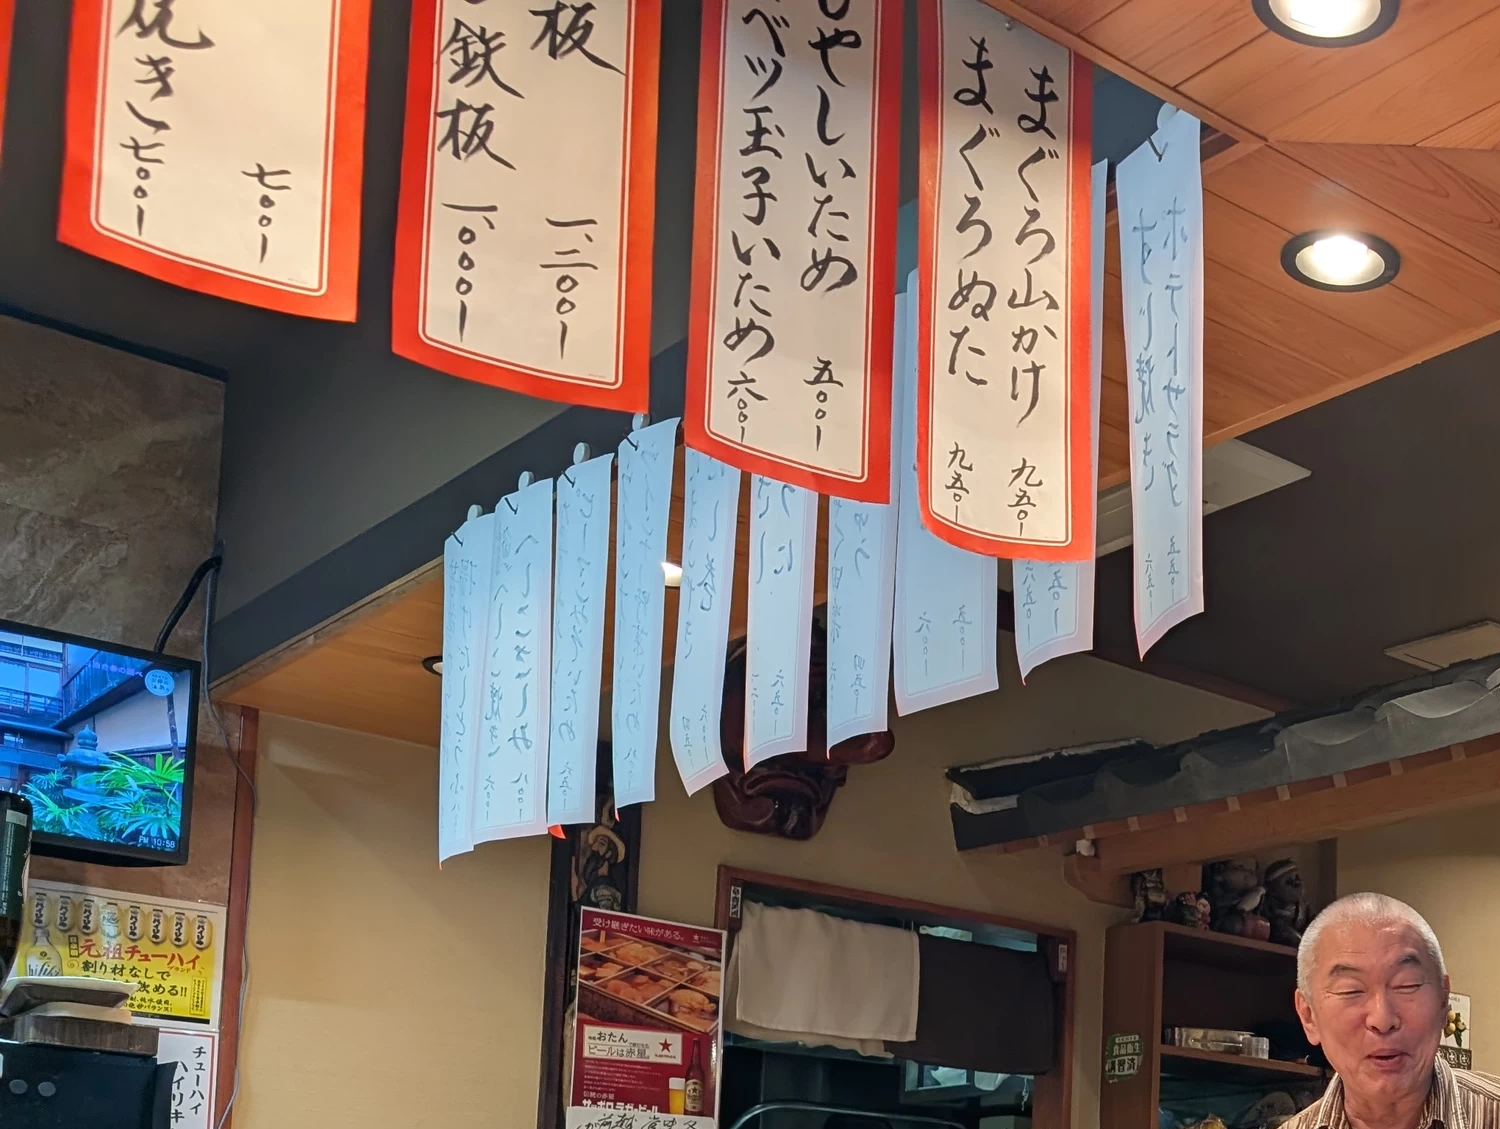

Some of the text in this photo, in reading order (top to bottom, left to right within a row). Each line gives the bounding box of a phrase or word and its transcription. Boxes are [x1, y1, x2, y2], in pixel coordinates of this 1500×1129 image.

[435, 0, 526, 172] 鉄板
[722, 0, 791, 366] ベツ玉子いため
[947, 36, 1000, 387] まぐろぬた
[1007, 66, 1060, 429] まぐろ山かけ
[138, 835, 176, 849] PM 10:58
[80, 938, 200, 971] 元祖チューハイ
[592, 917, 685, 941] 受け継ぎたい味がある。
[82, 960, 172, 981] 割り材なしで
[596, 1031, 628, 1043] おたん
[189, 1046, 207, 1115] チューハイ
